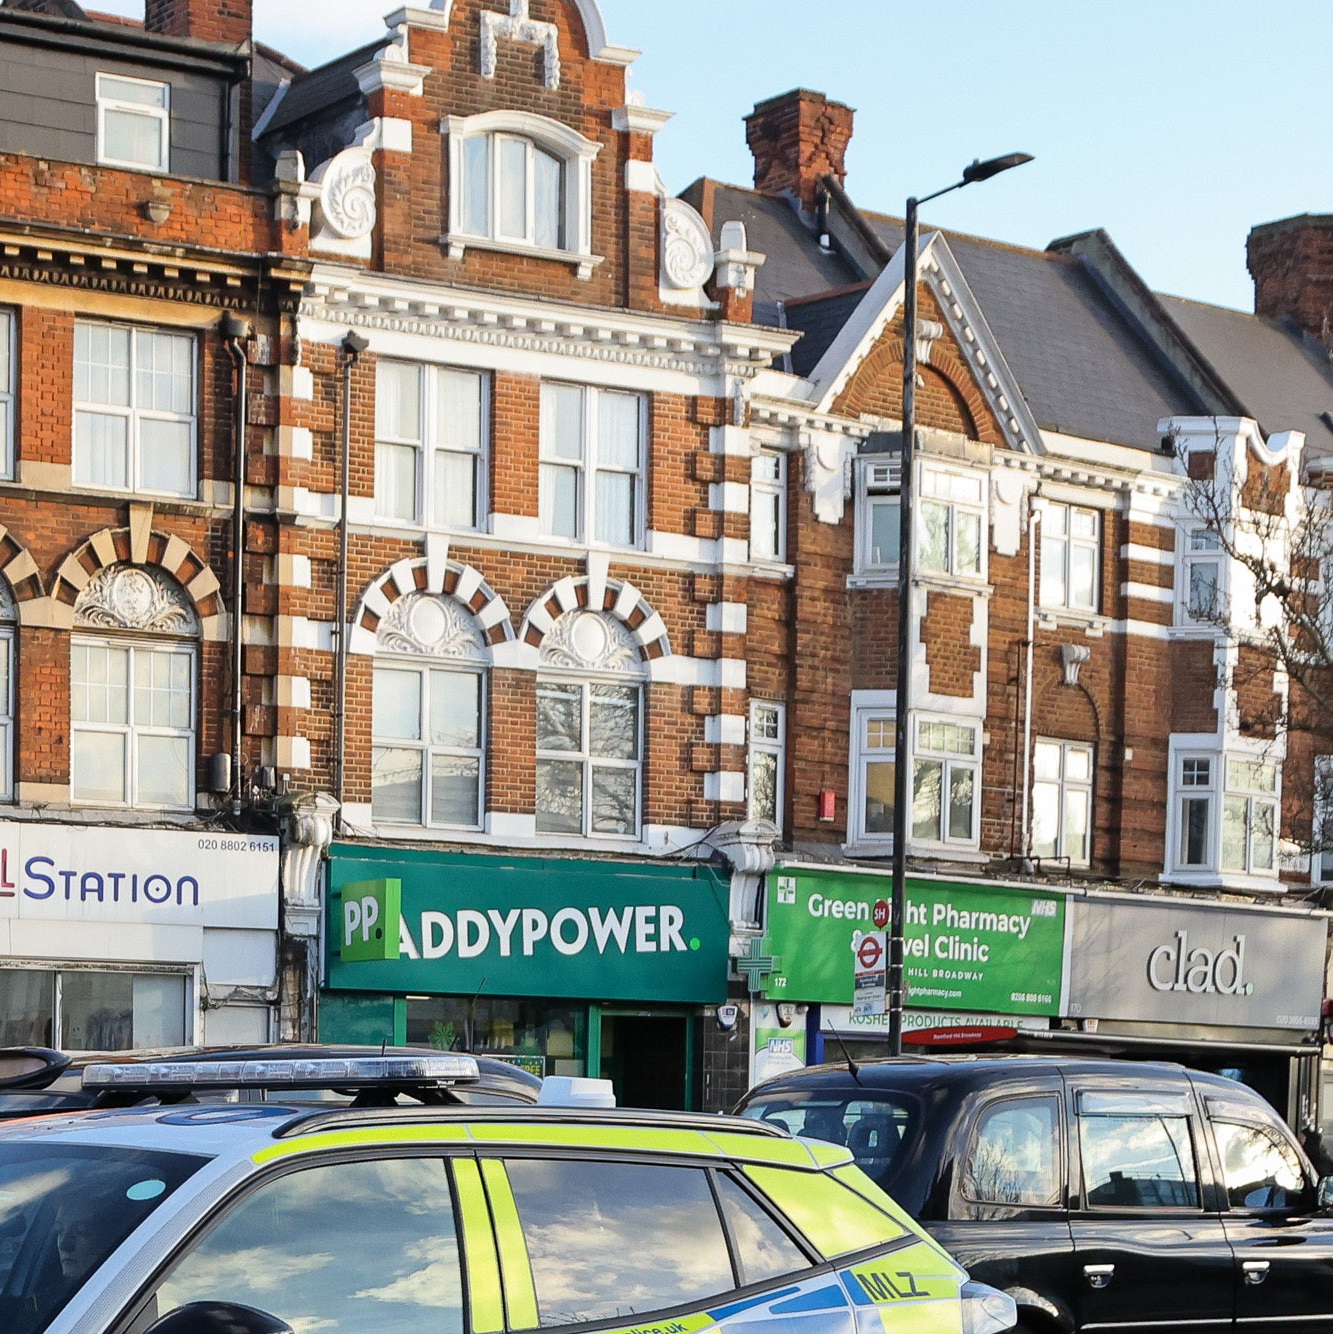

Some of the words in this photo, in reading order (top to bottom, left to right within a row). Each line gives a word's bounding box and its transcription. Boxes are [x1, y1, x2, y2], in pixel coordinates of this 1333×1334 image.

[198, 840, 217, 849] 020
[220, 841, 246, 851] 8802
[249, 842, 275, 852] 6151
[874, 909, 886, 920] SH
[1032, 900, 1056, 916] NHS
[808, 893, 870, 920] Green
[933, 901, 1031, 940] Pharmacy
[399, 905, 701, 959] ADDYPOWER.
[935, 934, 989, 963] Clinic
[1147, 931, 1254, 995] clad.
[774, 977, 787, 988] 172
[908, 968, 928, 977] HILL
[933, 969, 984, 981] BROADWAY
[849, 1012, 890, 1025] KOSHE
[901, 1014, 961, 1028] PRODUCTS
[769, 1041, 791, 1052] NHS
[858, 1272, 930, 1303] MLZ
